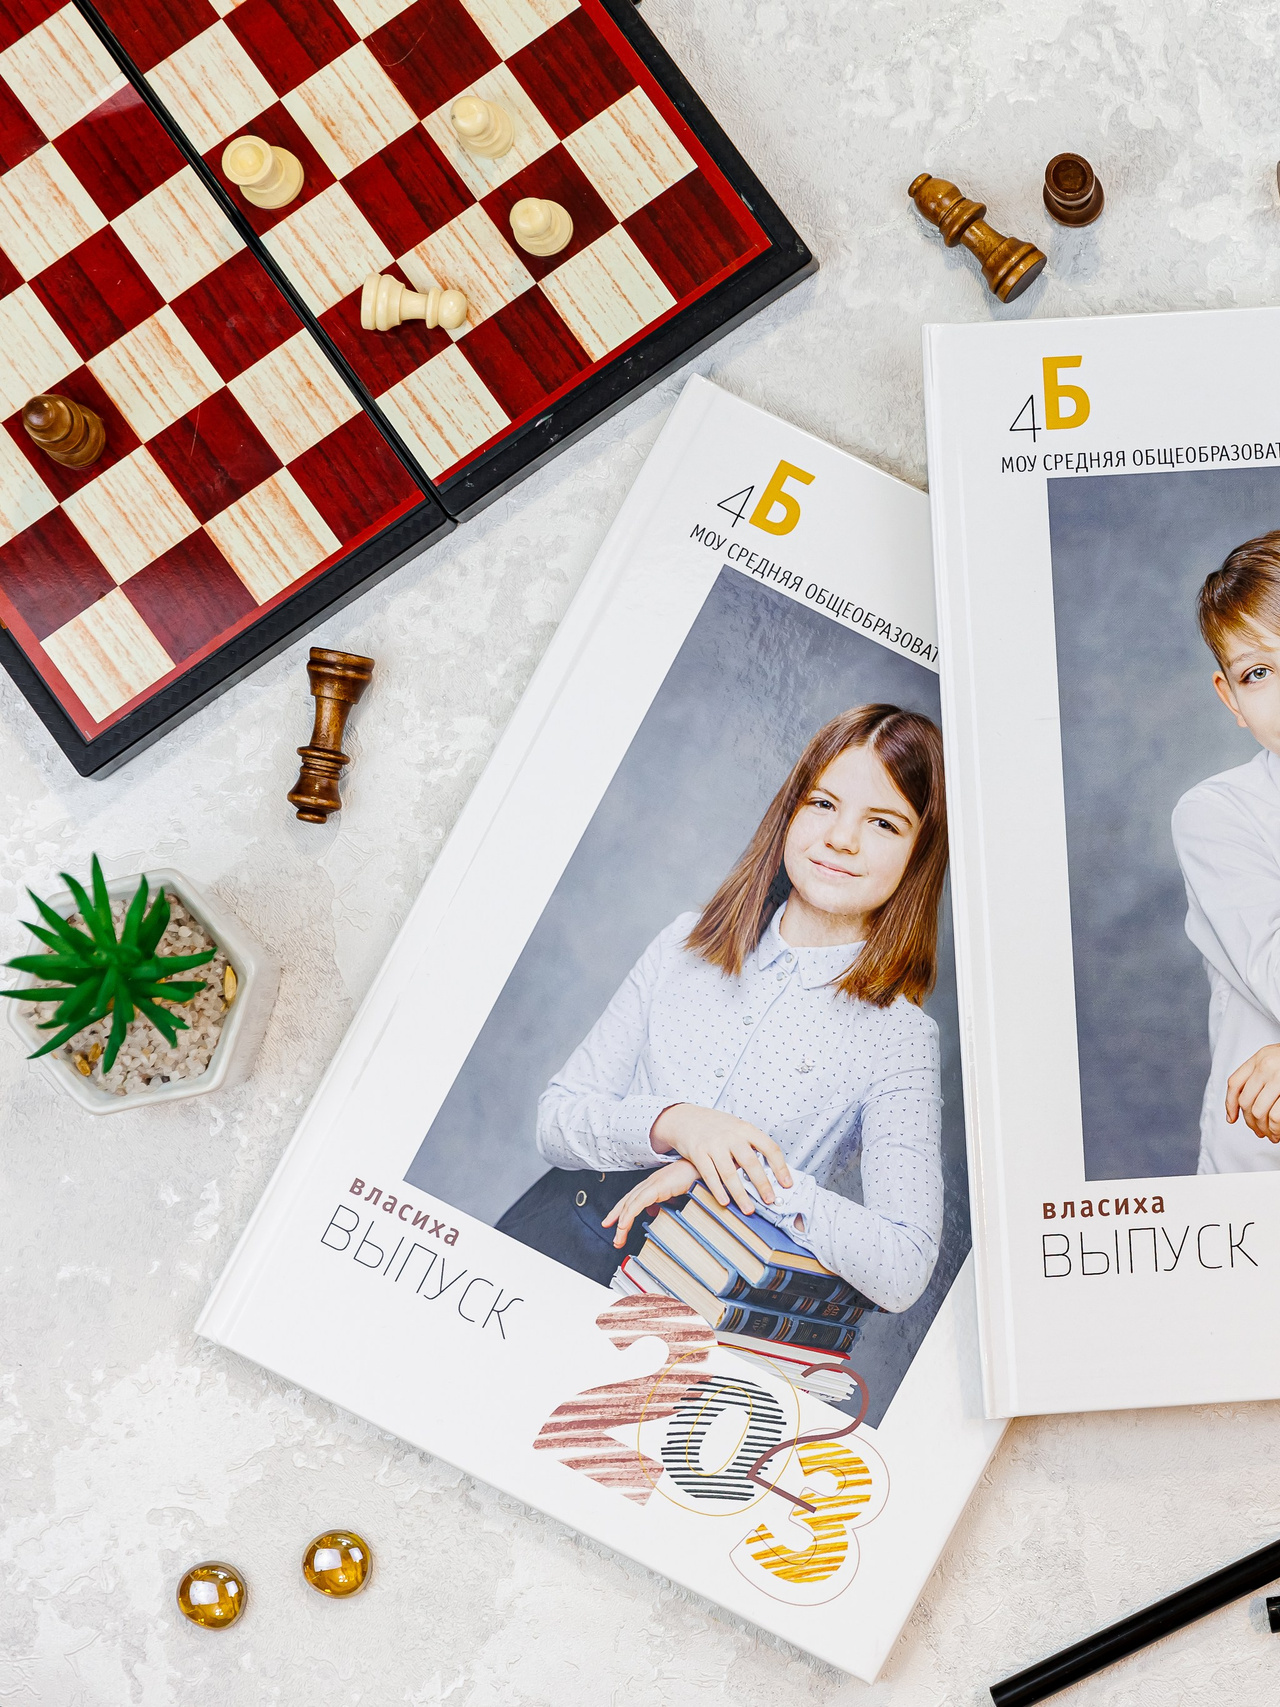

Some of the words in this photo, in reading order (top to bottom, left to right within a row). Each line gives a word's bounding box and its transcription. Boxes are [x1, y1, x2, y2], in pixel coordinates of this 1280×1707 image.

[1009, 355, 1091, 443] 4Б
[1001, 454, 1037, 474] МОУ
[1043, 450, 1126, 474] СРЕДНЯЯ
[716, 459, 816, 537] 4Б
[689, 523, 728, 551] МОУ
[727, 543, 804, 593] СРЕДНЯЯ
[349, 1177, 461, 1247] власиха
[1042, 1195, 1166, 1220] власиха
[320, 1204, 525, 1340] ВЫПУСК
[1042, 1221, 1259, 1278] ВЫПУСК
